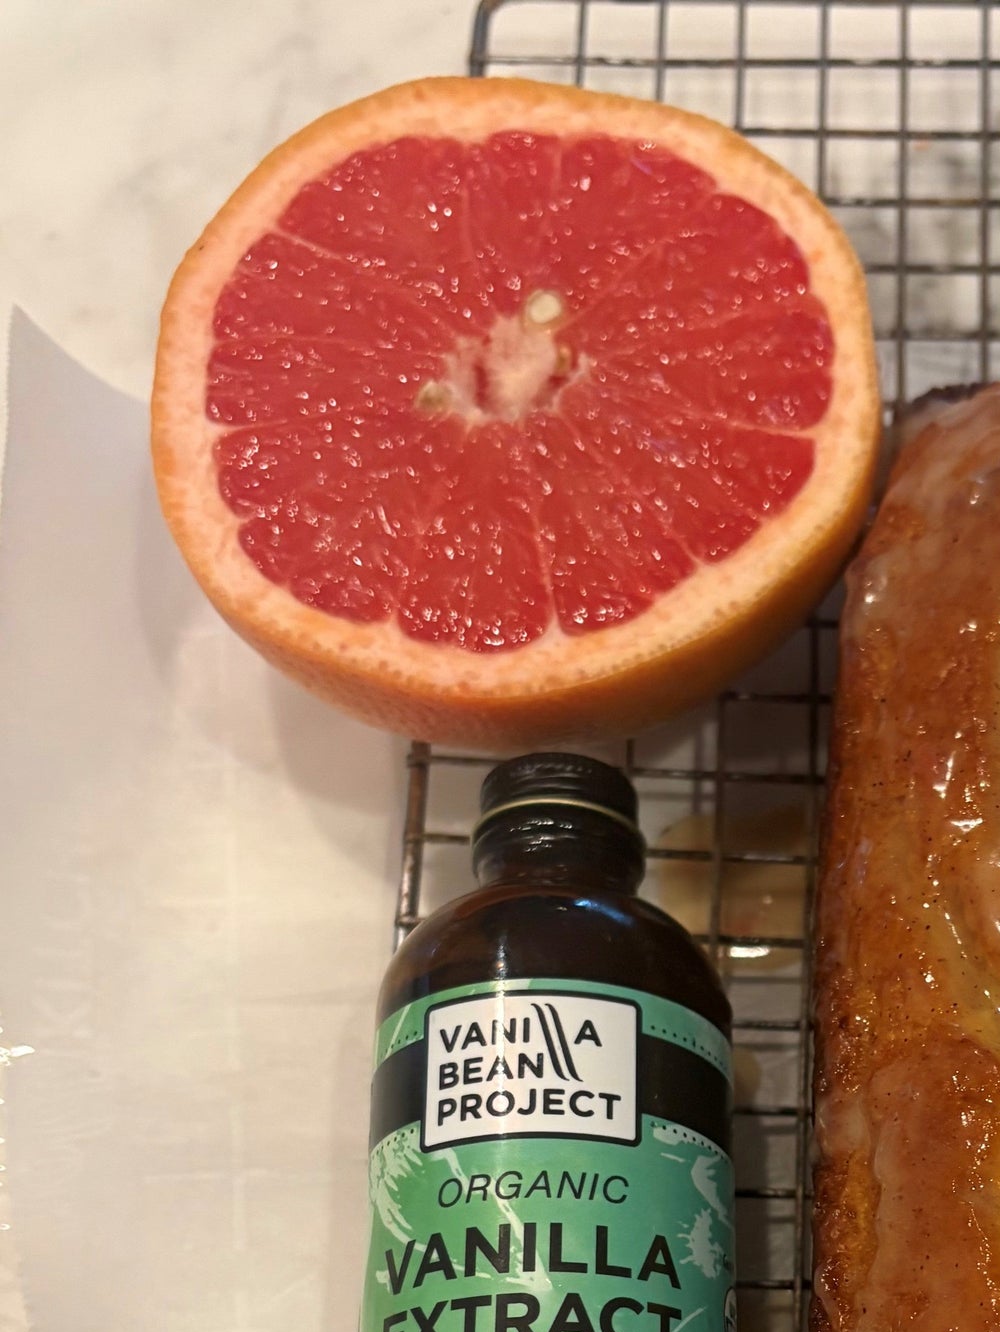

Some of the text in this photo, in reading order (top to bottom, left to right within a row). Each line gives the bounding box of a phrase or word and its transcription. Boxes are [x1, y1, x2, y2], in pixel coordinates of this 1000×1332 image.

[438, 1052, 545, 1091] BEAN
[437, 1088, 622, 1126] PROJECT
[437, 1170, 630, 1208] ORGANIC
[385, 1222, 682, 1296] VANILLA
